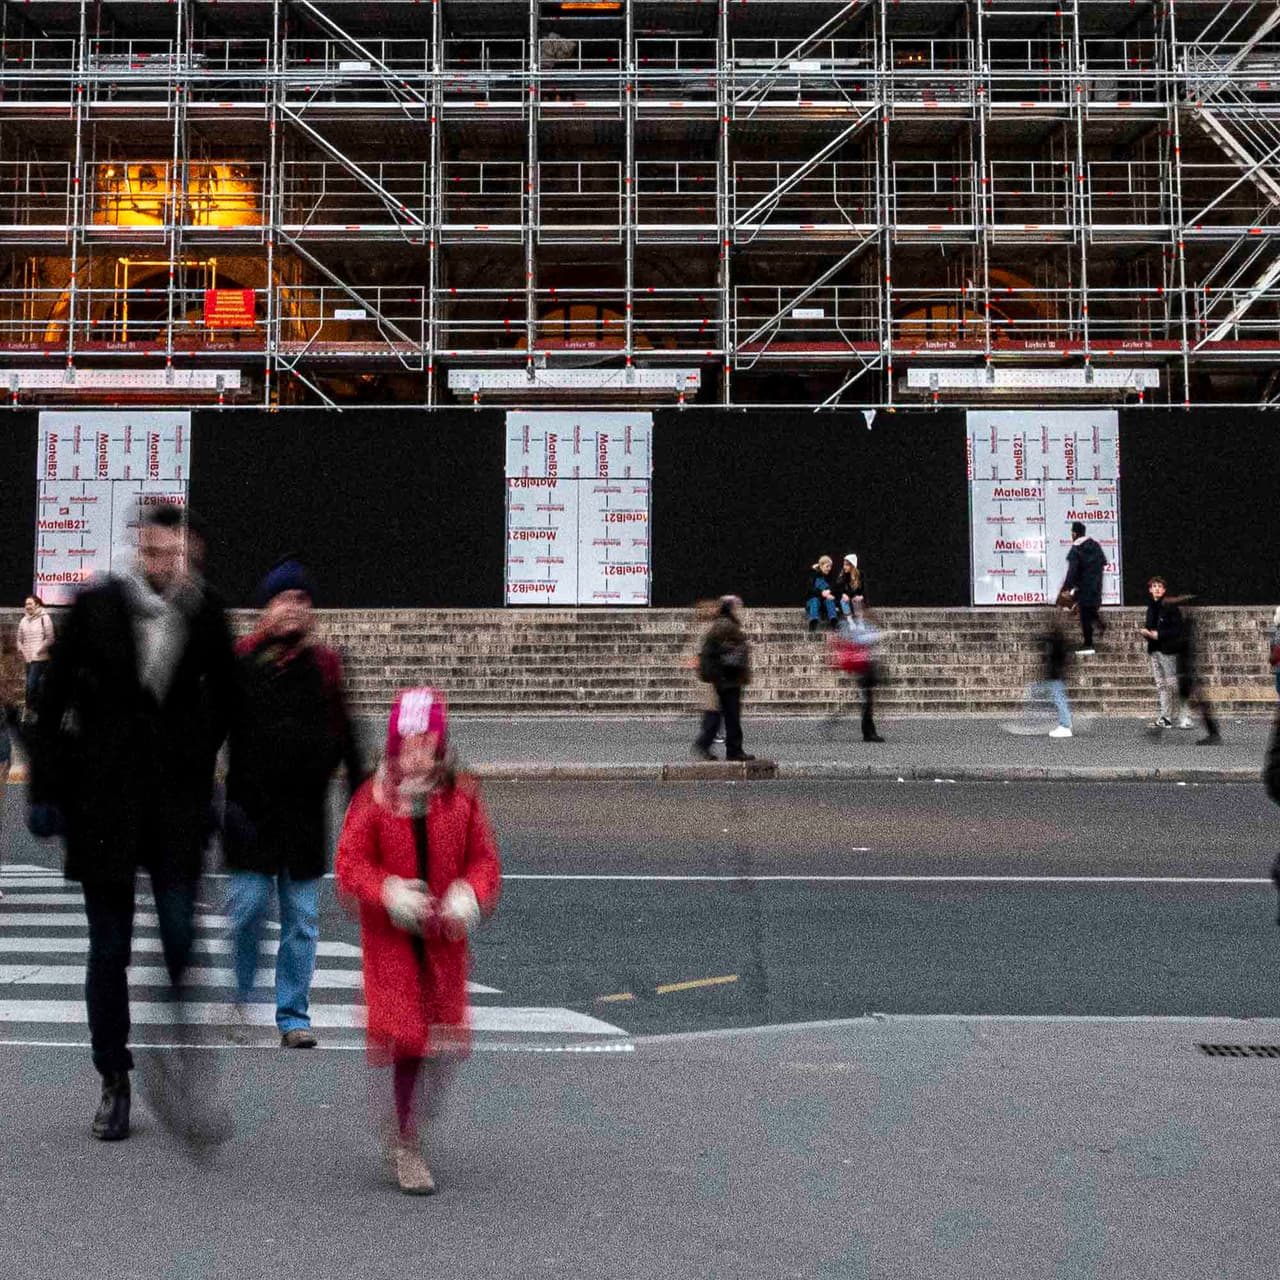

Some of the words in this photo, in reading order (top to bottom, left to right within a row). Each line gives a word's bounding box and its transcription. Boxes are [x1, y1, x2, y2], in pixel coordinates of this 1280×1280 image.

[994, 487, 1042, 497] MatelB21
[1066, 510, 1115, 520] MatelB21
[996, 593, 1045, 602] MatelB21
